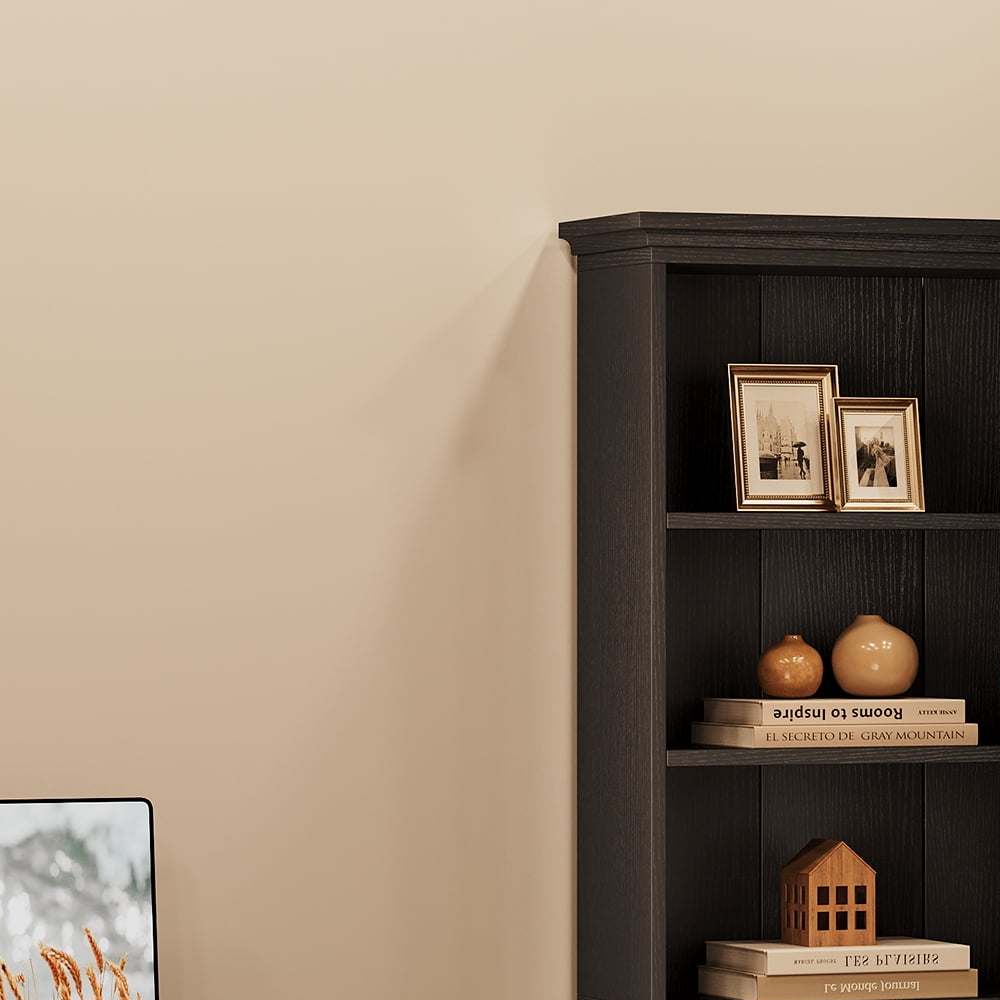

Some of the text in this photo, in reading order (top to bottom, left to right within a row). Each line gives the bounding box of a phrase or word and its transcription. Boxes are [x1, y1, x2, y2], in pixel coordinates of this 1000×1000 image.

[773, 705, 903, 722] Rooms to Inspire
[766, 730, 965, 742] EL SECRETO DE GRAY MOUNTAIN
